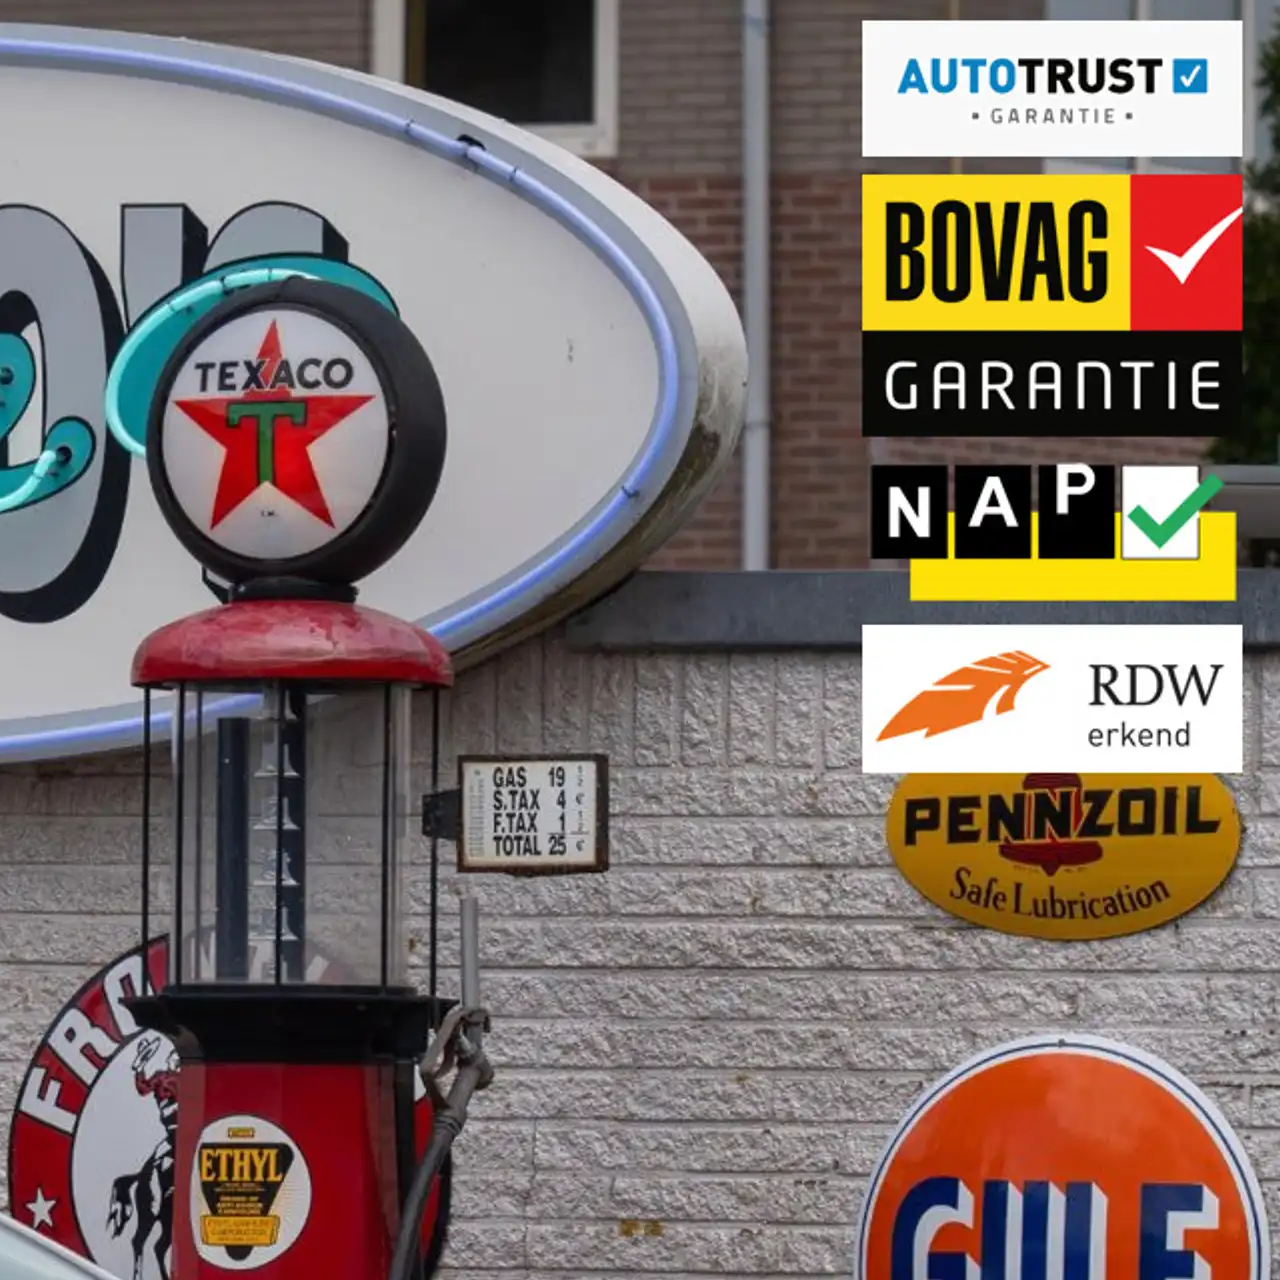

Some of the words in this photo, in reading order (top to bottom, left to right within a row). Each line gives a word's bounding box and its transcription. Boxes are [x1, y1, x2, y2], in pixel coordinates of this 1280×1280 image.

[195, 358, 354, 392] TEXACO
[492, 766, 528, 788] GAS
[548, 766, 566, 788] 19
[492, 789, 540, 811] S.TAX
[556, 789, 566, 810] 4
[492, 811, 538, 834] F.TAX
[904, 785, 1221, 846] PENNZOIL
[492, 835, 542, 857] TOTAL
[548, 835, 567, 856] 25
[950, 866, 1008, 910] Safe
[1012, 878, 1170, 920] Lubrication
[201, 1148, 283, 1182] ETHYL
